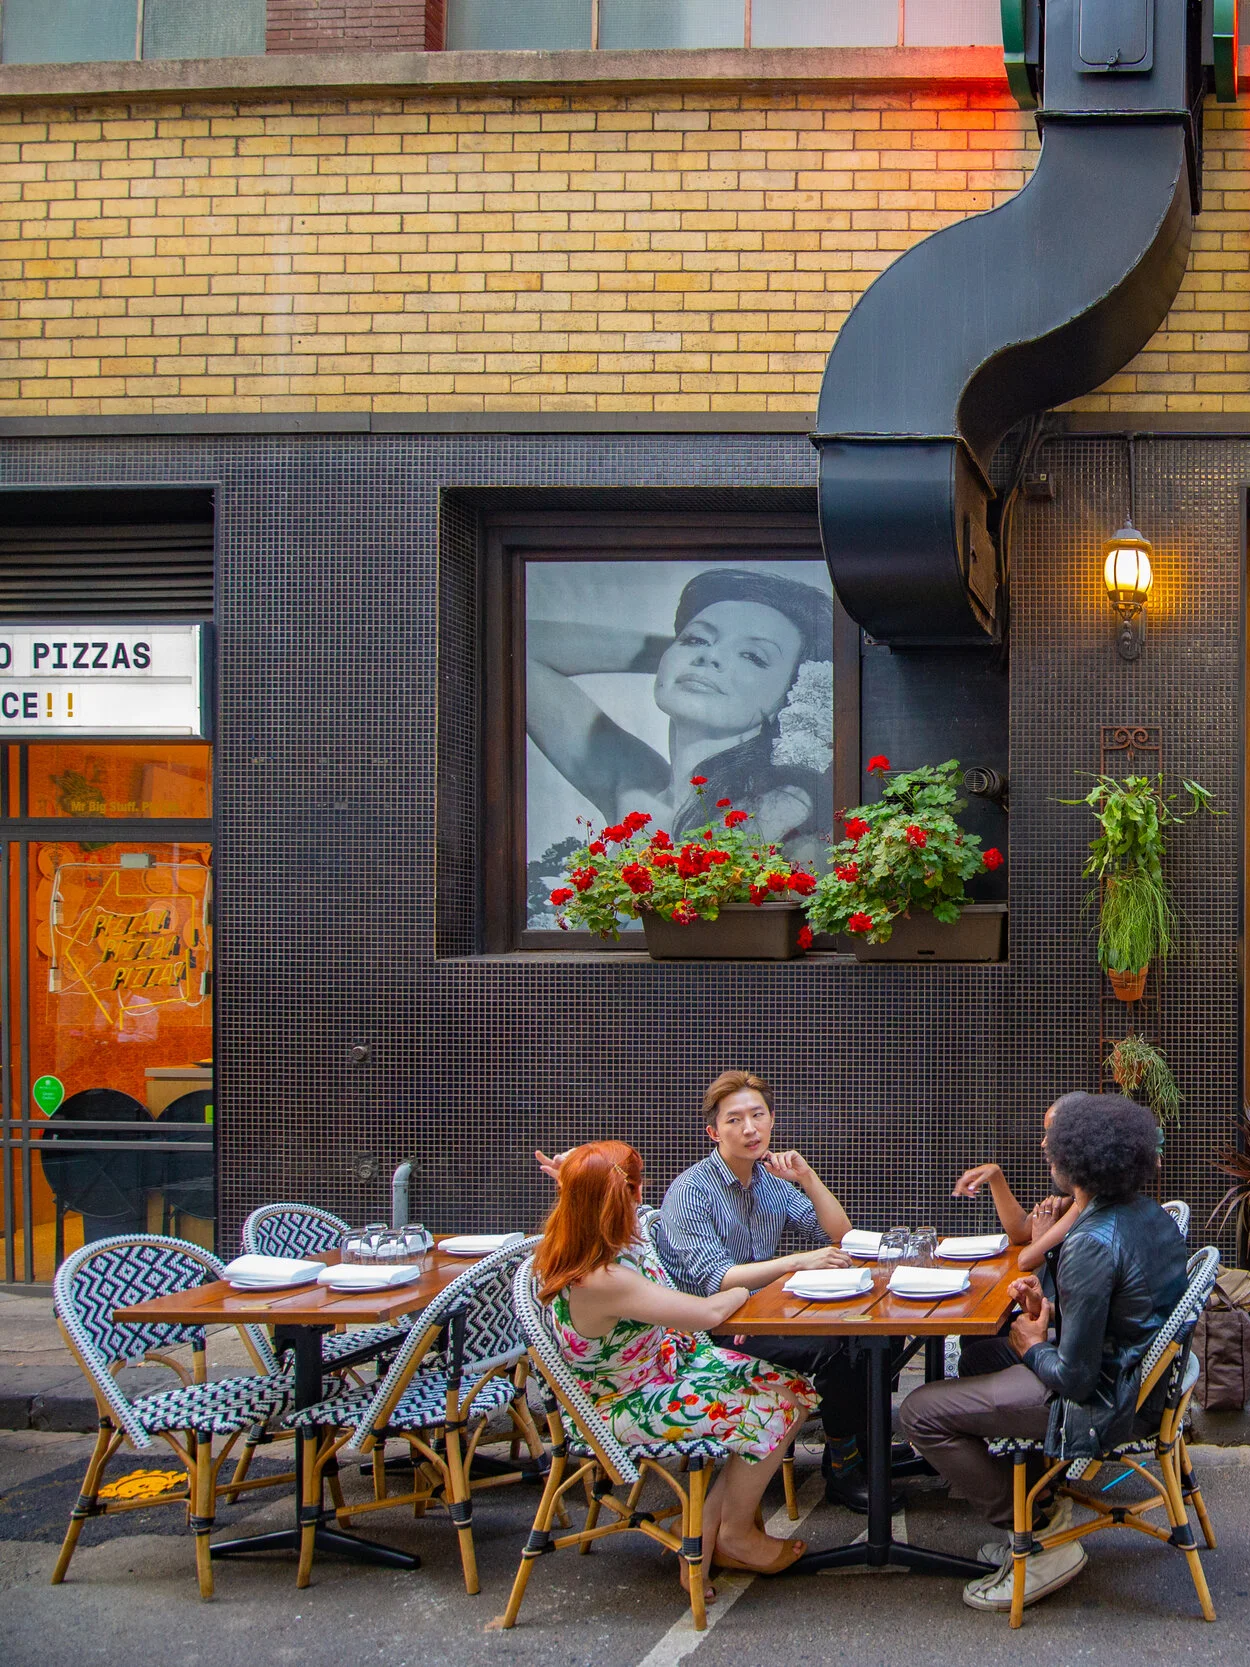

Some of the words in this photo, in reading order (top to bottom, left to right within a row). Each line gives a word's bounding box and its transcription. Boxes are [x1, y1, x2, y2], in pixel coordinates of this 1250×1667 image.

[33, 642, 151, 669] PIZZAS
[71, 801, 86, 812] Mr
[89, 801, 106, 814] Big
